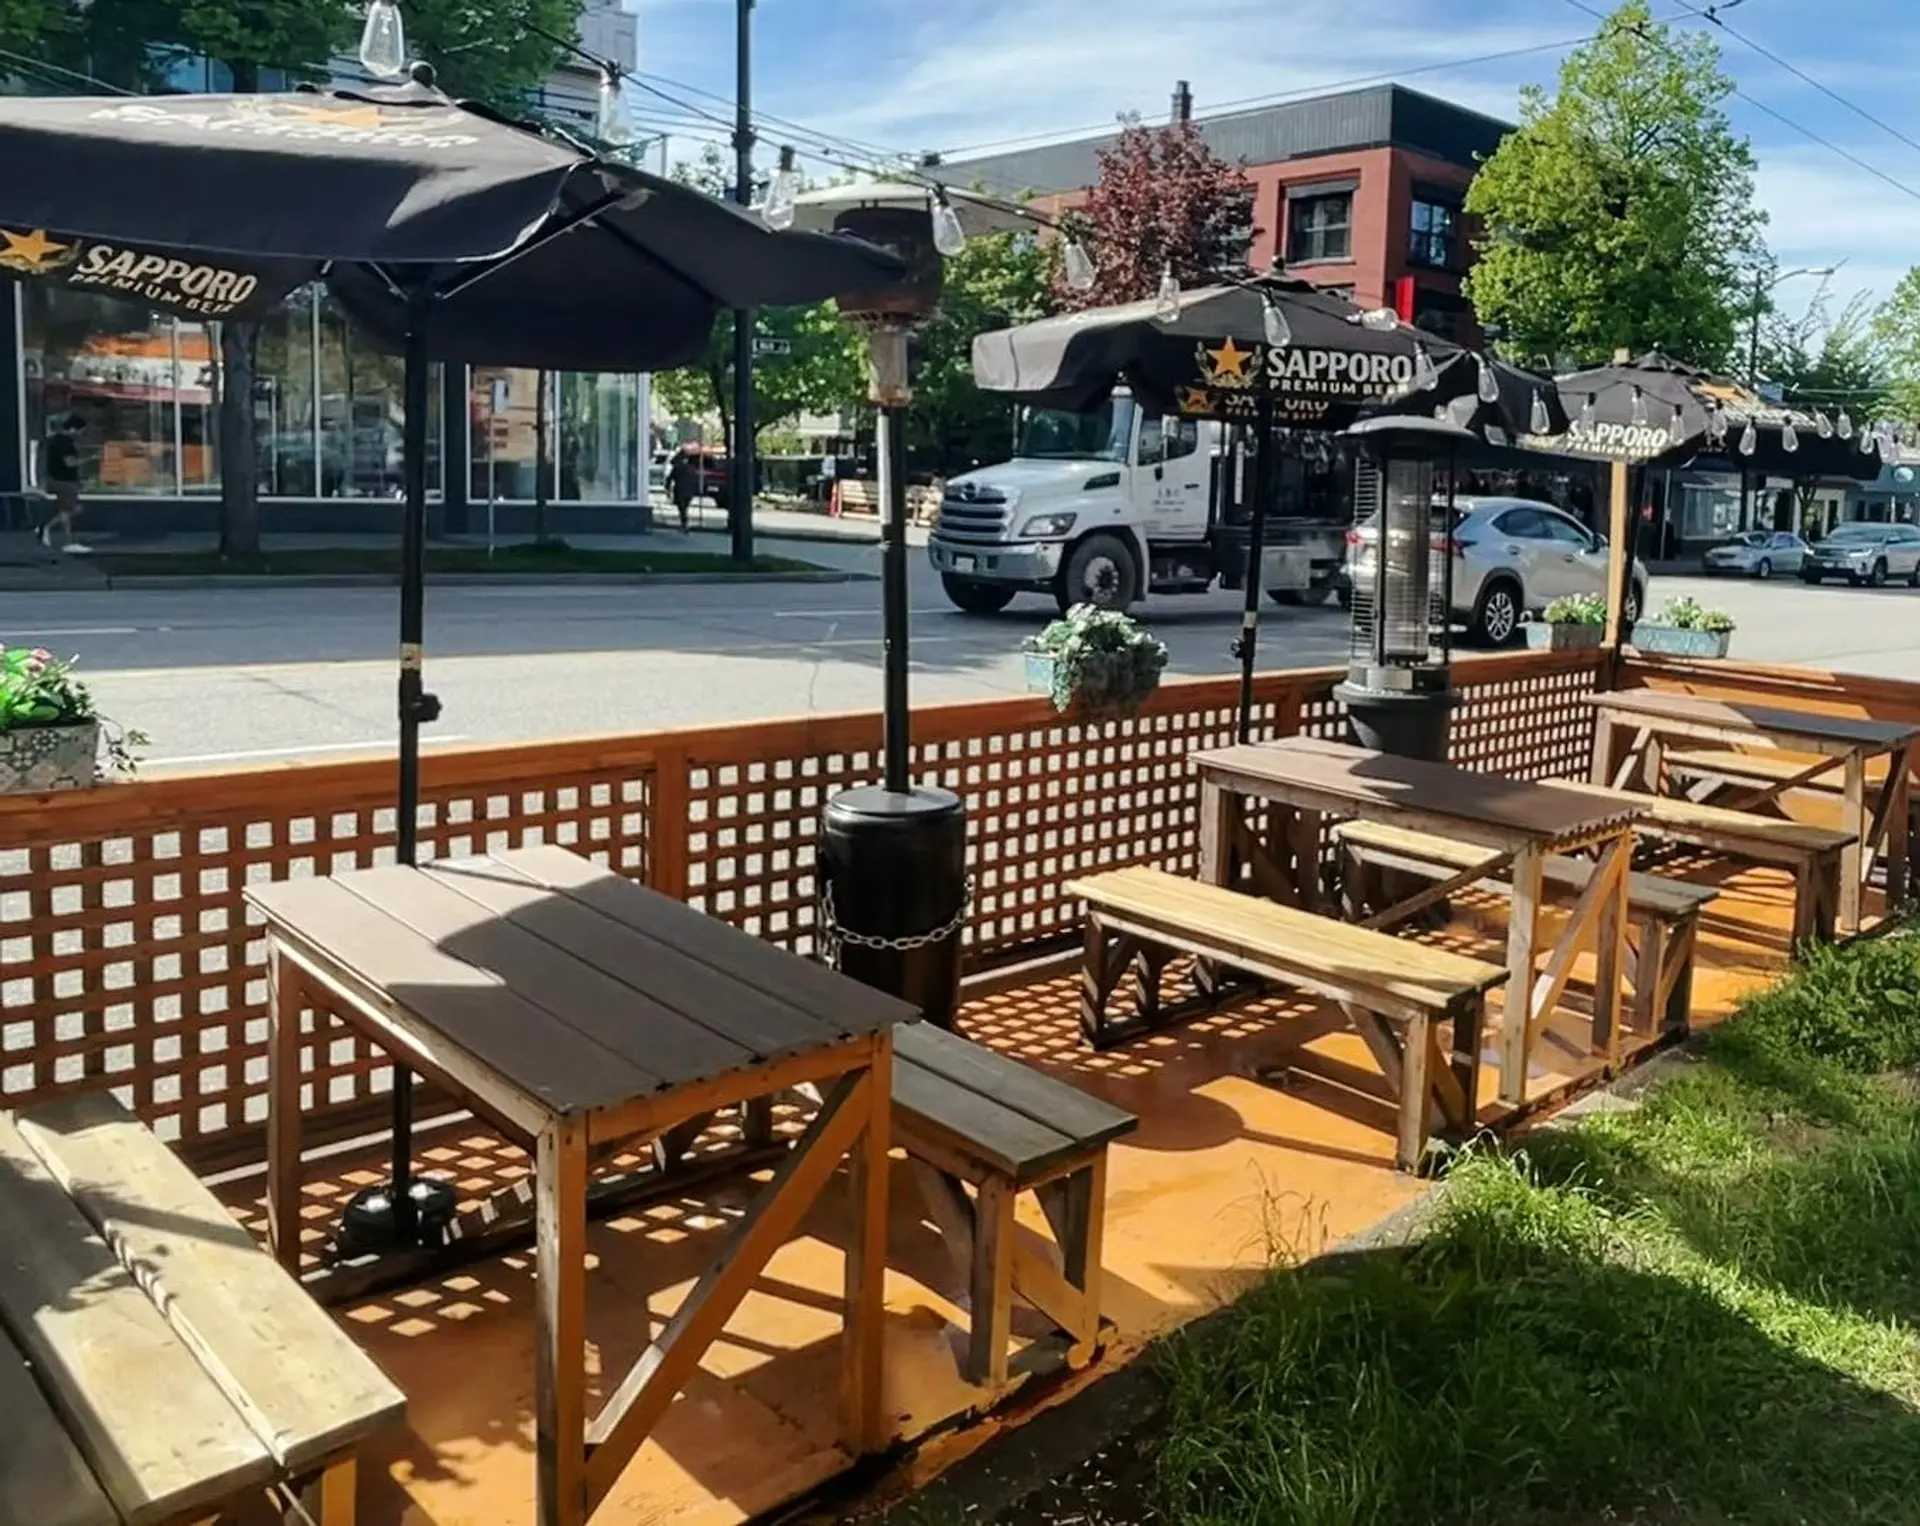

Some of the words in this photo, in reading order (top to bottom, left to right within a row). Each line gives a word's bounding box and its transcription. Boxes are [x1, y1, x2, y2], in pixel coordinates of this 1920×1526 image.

[77, 245, 258, 304] SAPPORO
[1266, 348, 1413, 383] SAPPORO
[1269, 379, 1357, 395] PREMIUM
[1567, 419, 1669, 447] SAPPORO
